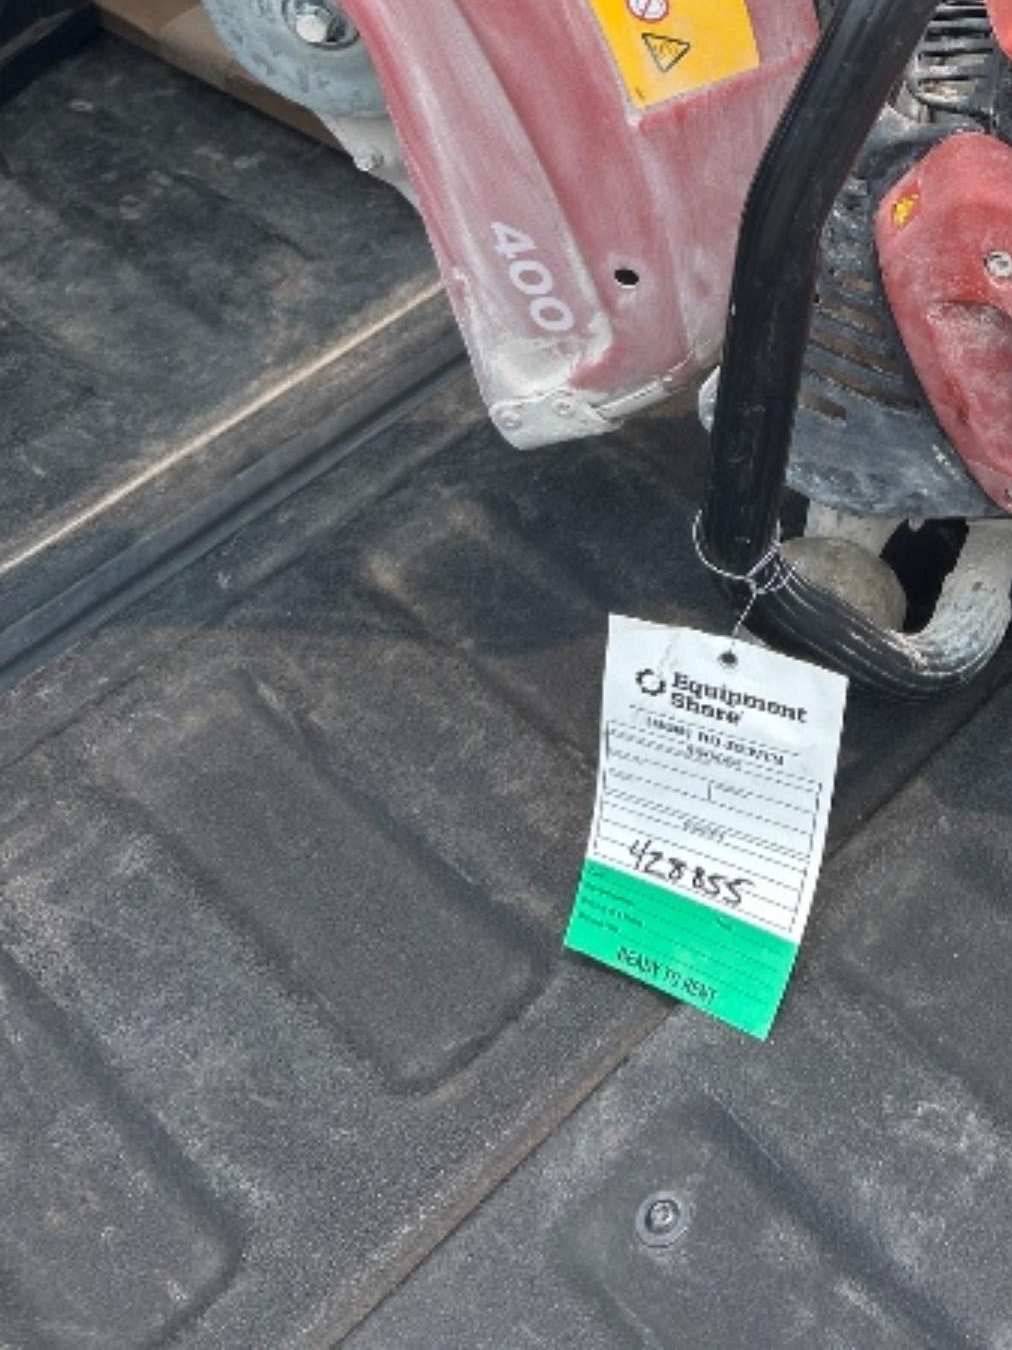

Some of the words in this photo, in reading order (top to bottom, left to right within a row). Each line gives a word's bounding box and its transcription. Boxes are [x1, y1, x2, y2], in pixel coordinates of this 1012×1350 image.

[490, 220, 576, 332] 400
[670, 692, 742, 726] Share
[671, 671, 808, 724] Equipment
